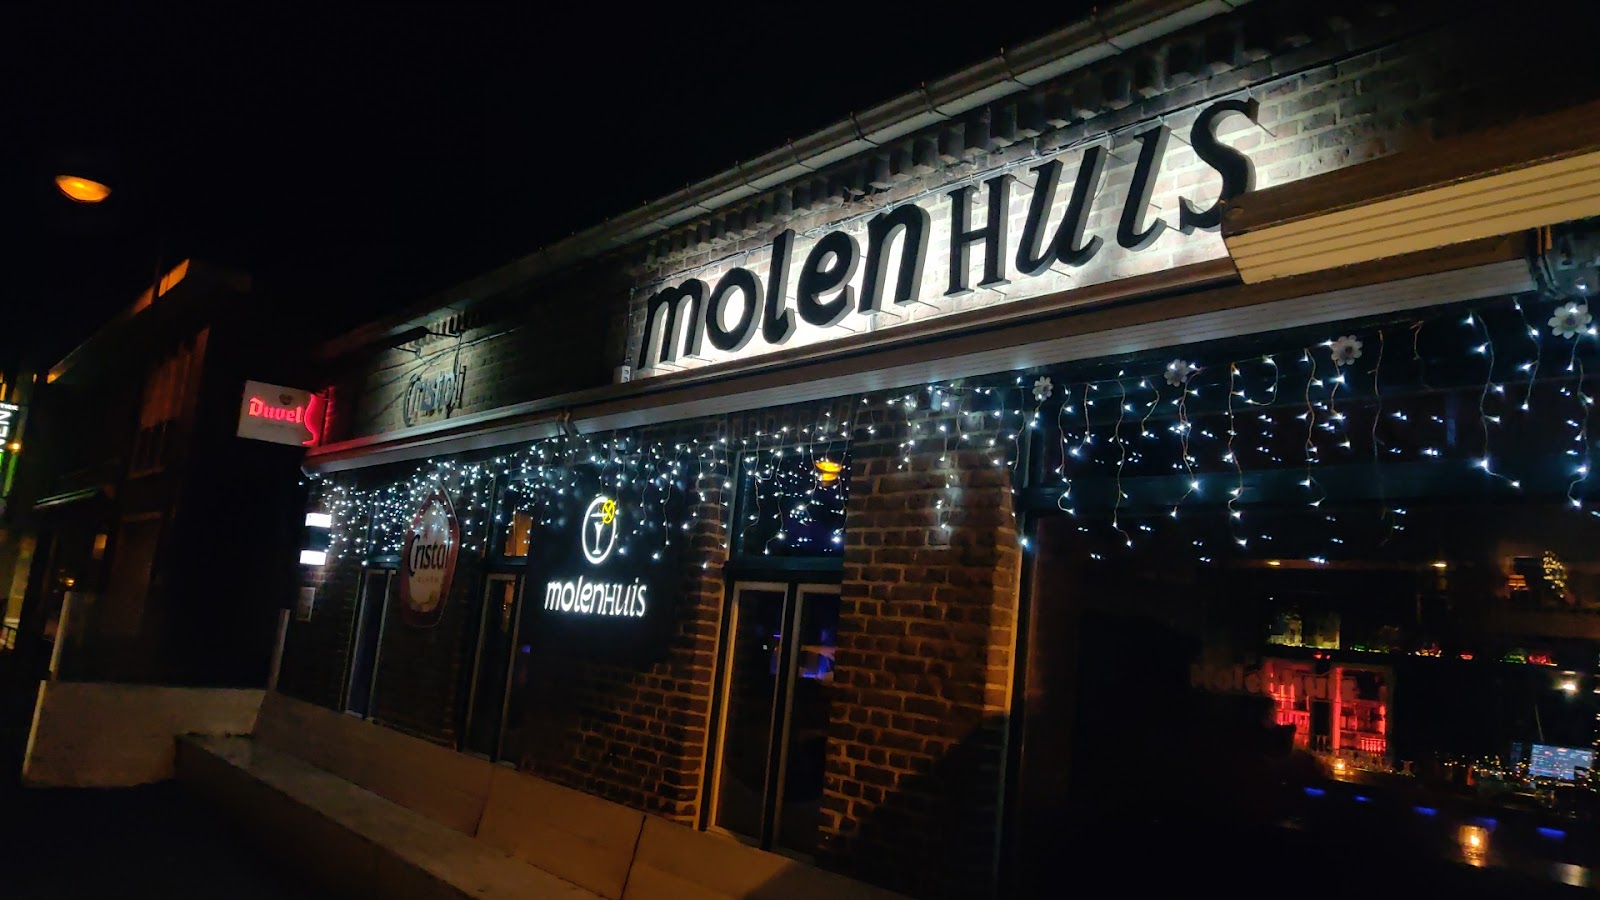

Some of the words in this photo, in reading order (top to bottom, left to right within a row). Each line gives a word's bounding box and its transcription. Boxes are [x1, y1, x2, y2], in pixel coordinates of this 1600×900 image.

[248, 397, 302, 423] Duvel
[408, 534, 450, 577] Cristal
[543, 575, 648, 618] molenHuis
